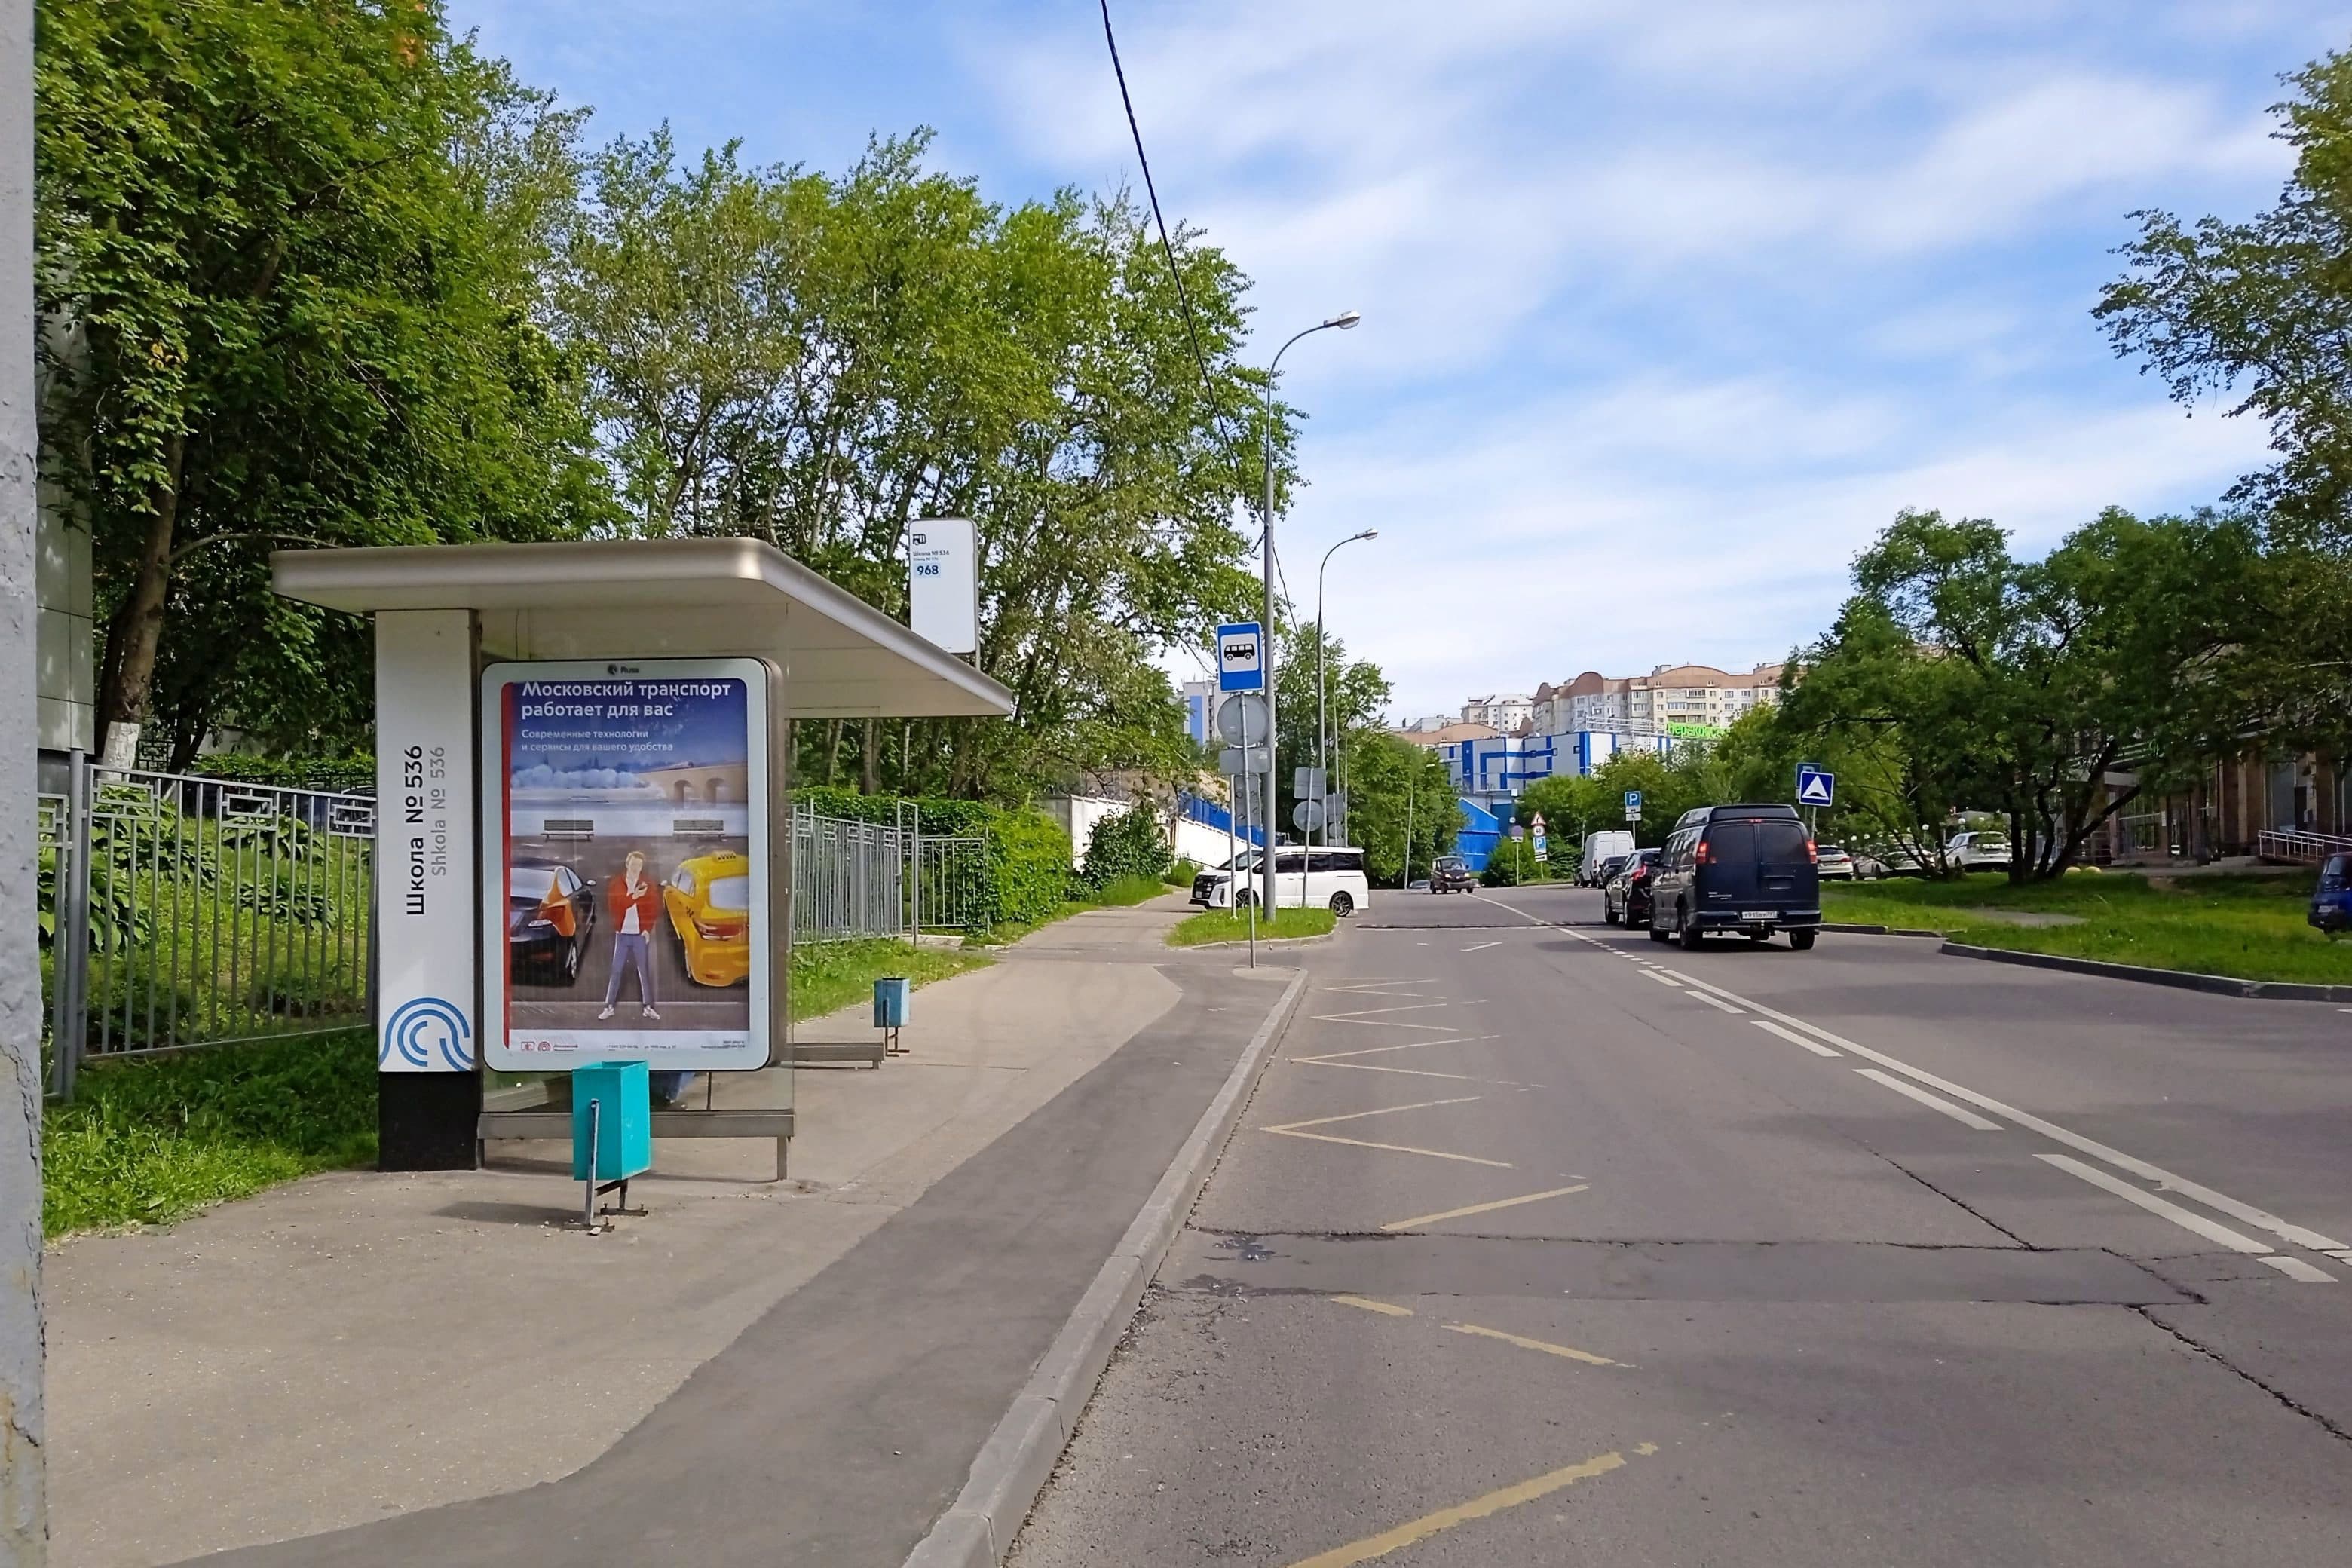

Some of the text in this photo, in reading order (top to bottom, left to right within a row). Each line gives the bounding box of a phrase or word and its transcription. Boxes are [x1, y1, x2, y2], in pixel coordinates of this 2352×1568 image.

[917, 565, 939, 575] 968
[522, 681, 731, 700] Московский транспорт
[522, 701, 673, 720] работает для вас
[521, 729, 591, 740] Современные
[530, 743, 571, 752] сервисы
[592, 743, 627, 752] вашего
[629, 742, 673, 752] удобства
[1629, 793, 1638, 805] P
[430, 746, 446, 876] Shkola № 536
[404, 745, 425, 915] Школа № 536
